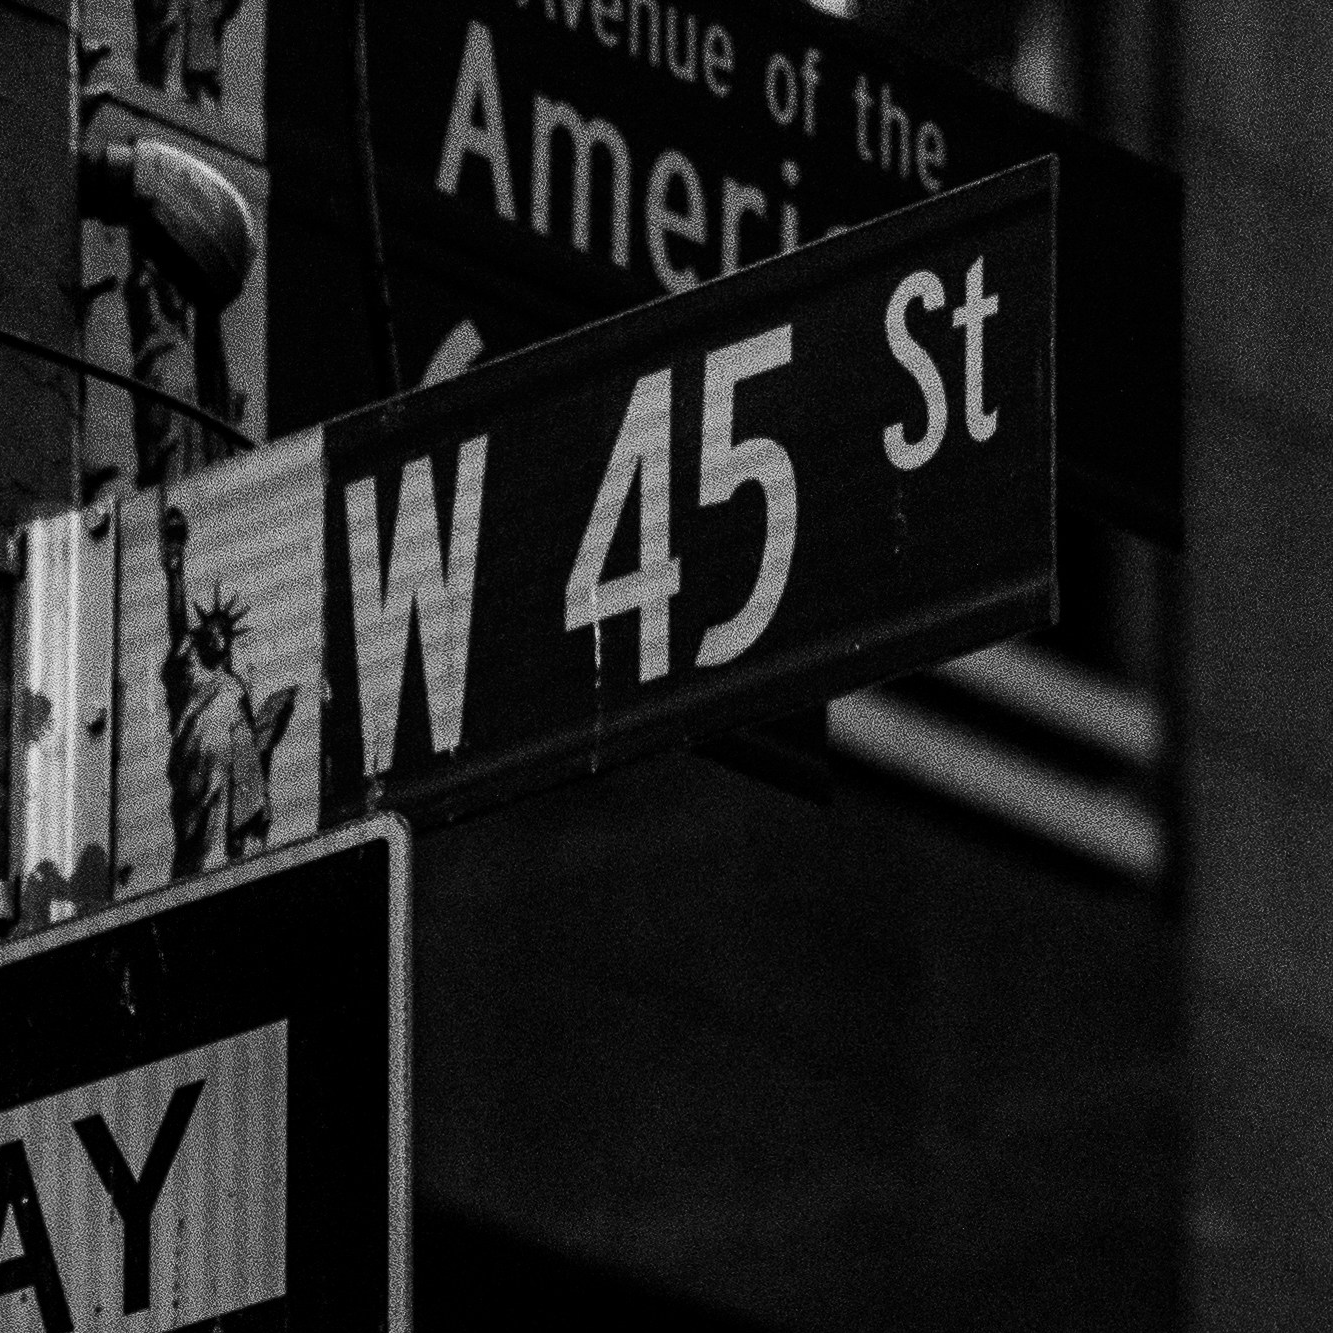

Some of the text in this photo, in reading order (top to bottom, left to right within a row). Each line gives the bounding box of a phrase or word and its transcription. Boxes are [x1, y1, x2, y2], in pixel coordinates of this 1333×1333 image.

[436, 20, 848, 293] Ameri
[518, 0, 949, 190] enue of the
[344, 255, 999, 777] W 45 St
